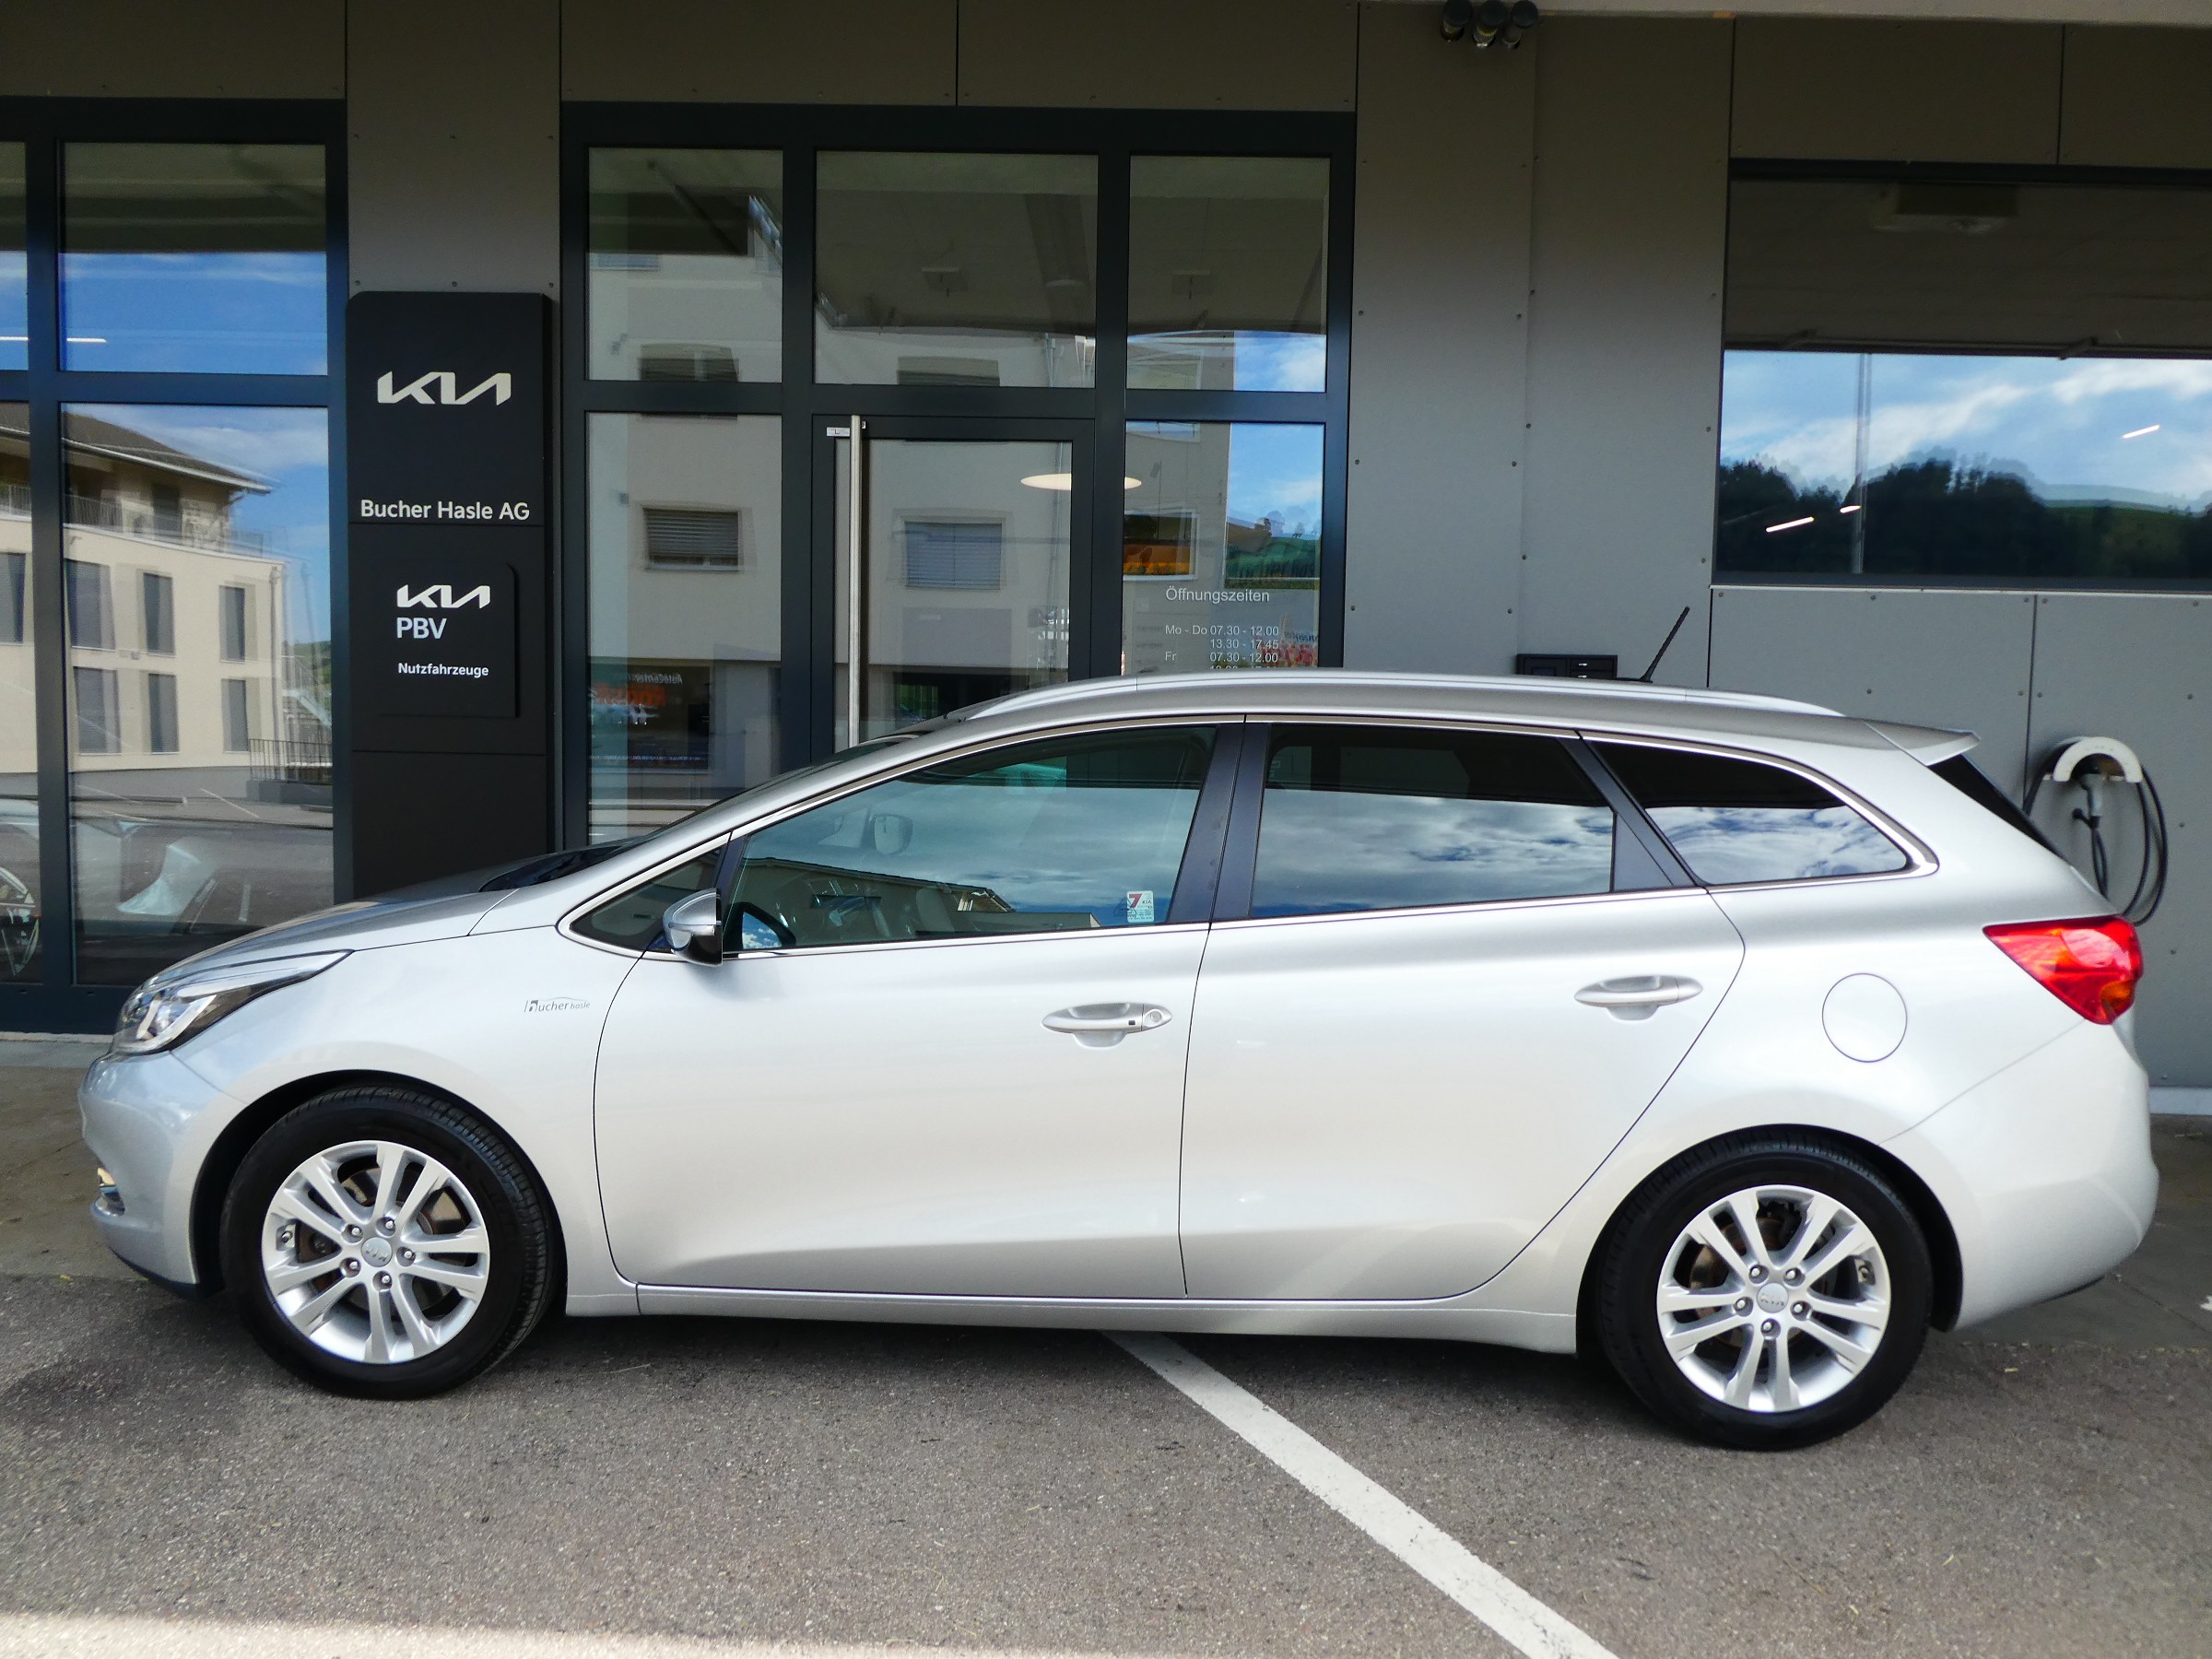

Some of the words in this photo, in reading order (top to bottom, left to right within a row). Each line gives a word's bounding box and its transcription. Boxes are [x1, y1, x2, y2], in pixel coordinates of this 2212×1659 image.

[377, 371, 512, 406] KIA
[360, 499, 432, 519] Bucher
[438, 500, 493, 520] Hasle
[499, 501, 530, 521] AG
[396, 584, 491, 609] KIA
[1165, 585, 1270, 605] Öffnungszeiten
[396, 617, 448, 640] PBV
[1165, 625, 1182, 636] Mo
[1192, 625, 1207, 636] Do
[1209, 625, 1240, 636] 07.30
[1250, 626, 1279, 637] 12.00
[1210, 639, 1240, 649] 13.30
[1250, 639, 1279, 650] 17.45
[1165, 652, 1177, 662] Fr
[1209, 652, 1240, 663] 07.30
[1250, 653, 1278, 663] 12.00
[397, 662, 489, 678] Nutzfahrzeuge
